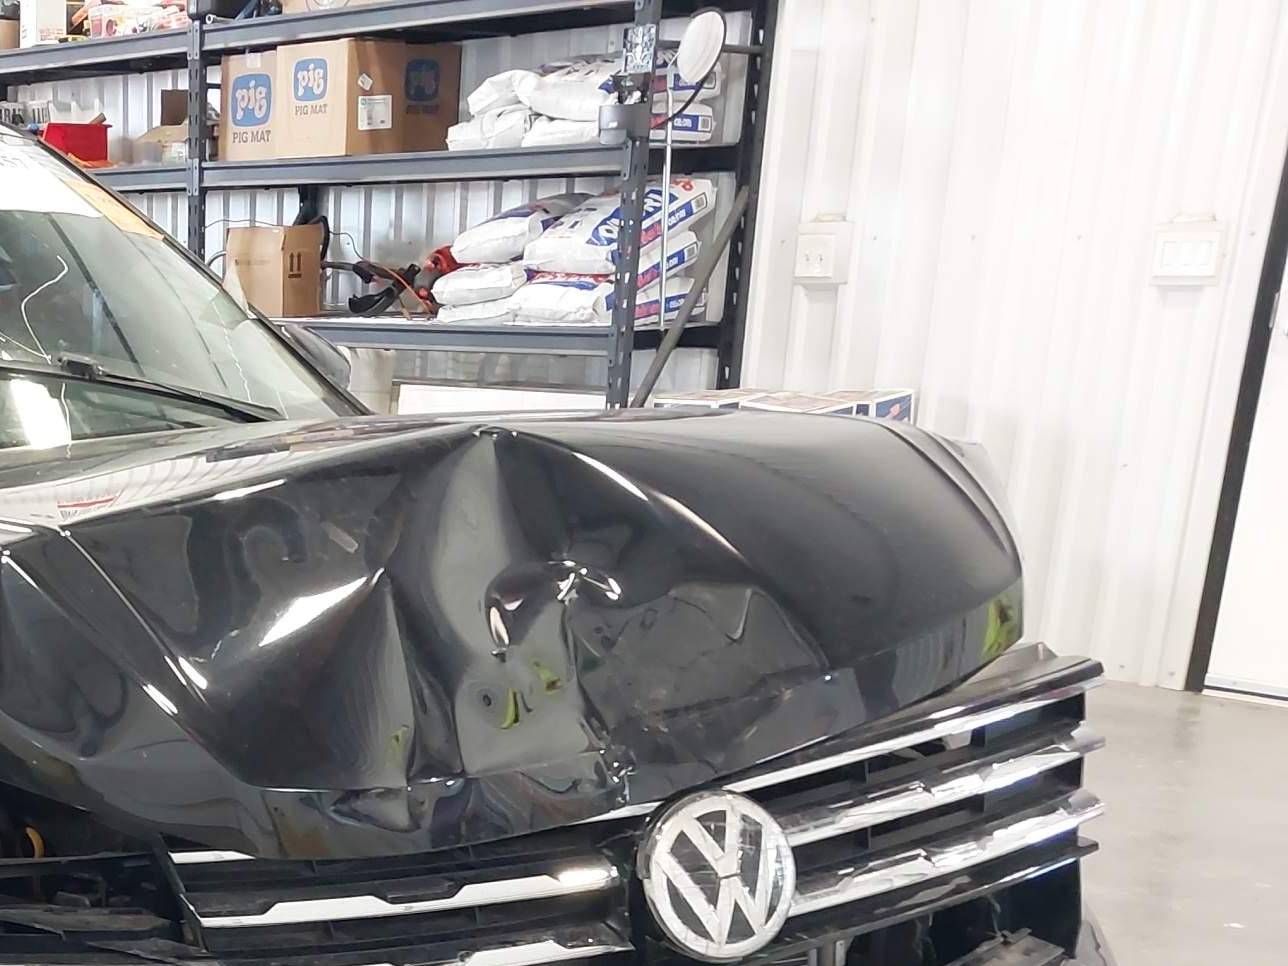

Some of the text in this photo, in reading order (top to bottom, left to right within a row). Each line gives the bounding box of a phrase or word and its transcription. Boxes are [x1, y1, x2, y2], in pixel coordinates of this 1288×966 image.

[297, 63, 324, 97] pig
[235, 80, 267, 120] pig
[295, 104, 328, 116] PIG MAT
[232, 130, 272, 144] PIG MAT
